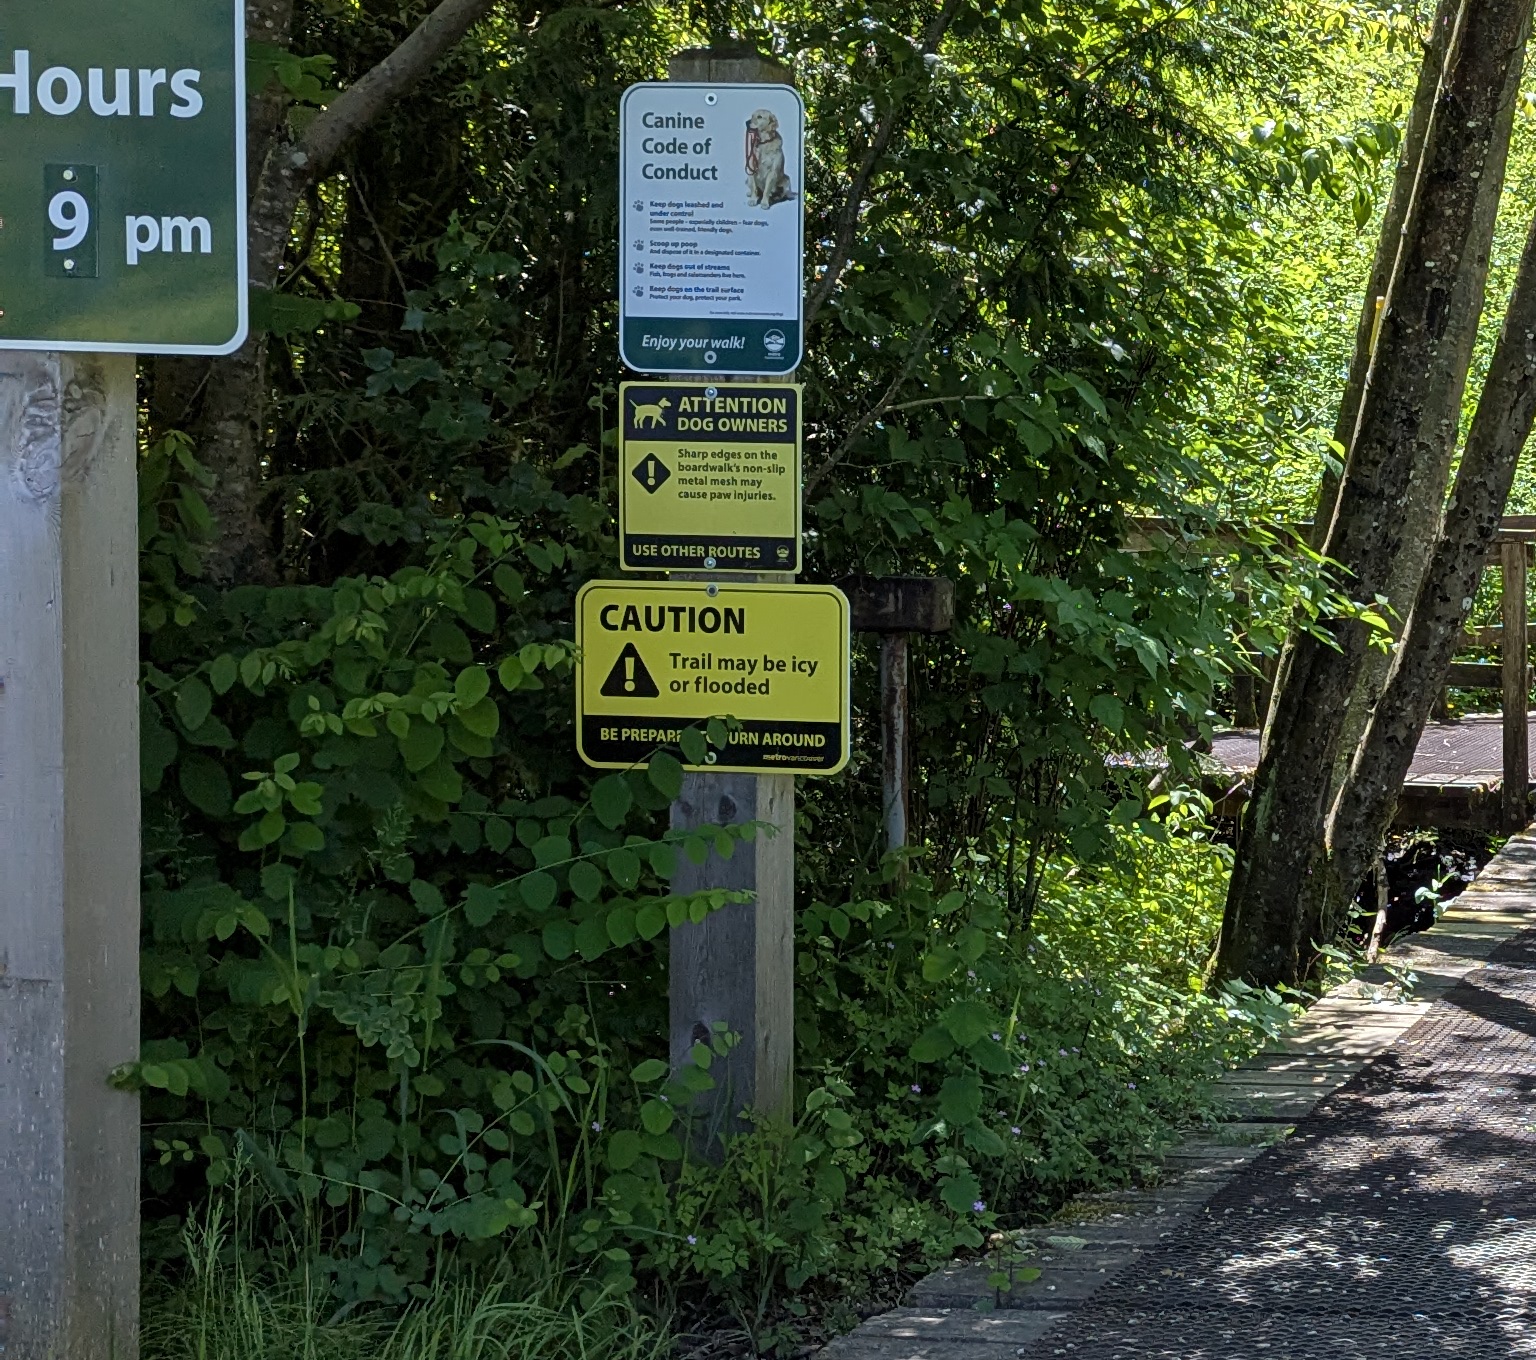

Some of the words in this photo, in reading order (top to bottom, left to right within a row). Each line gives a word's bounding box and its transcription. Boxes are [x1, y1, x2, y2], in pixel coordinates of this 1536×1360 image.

[642, 111, 705, 129] Canine
[642, 137, 688, 154] Code
[692, 137, 712, 154] of
[642, 163, 718, 180] Conduct
[650, 201, 666, 209] Keep
[667, 201, 683, 209] dogs
[48, 190, 90, 250] 9
[125, 214, 212, 265] pm
[650, 240, 670, 248] Scoop
[642, 335, 677, 350] Enjoy
[678, 338, 709, 351] your
[711, 336, 745, 349] walk!
[678, 396, 787, 414] ATTENTION
[677, 417, 714, 431] DOG
[718, 418, 788, 433] OWNERS
[678, 448, 708, 460] Sharp
[711, 449, 741, 461] edges
[744, 451, 758, 460] on
[760, 449, 778, 460] the
[678, 462, 741, 472] boardwalk's
[743, 464, 786, 476] non-slip
[678, 476, 708, 486] metal
[710, 476, 738, 486] mesh
[740, 479, 763, 488] may
[678, 491, 707, 499] cause
[710, 492, 731, 501] paw
[734, 490, 776, 502] injuries.
[632, 544, 658, 556] USE
[661, 545, 706, 557] OTHER
[708, 546, 761, 559] ROUTES
[600, 604, 745, 634] CAUTION
[669, 653, 712, 671] Trail
[717, 658, 758, 675] may
[763, 655, 787, 672] be
[792, 655, 818, 677] icy
[669, 679, 689, 693] or
[694, 676, 770, 695] flooded
[600, 728, 618, 741] BE
[728, 731, 759, 745] URN
[762, 733, 826, 747] AROUND
